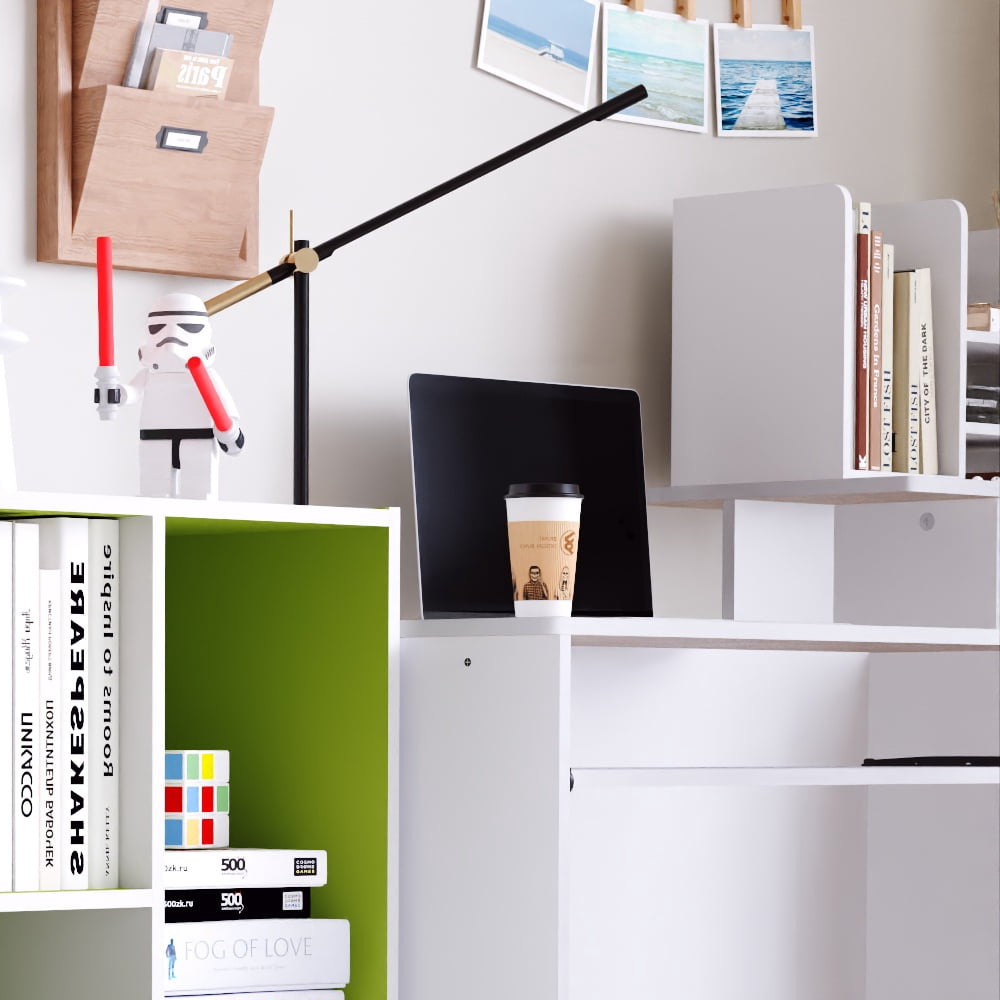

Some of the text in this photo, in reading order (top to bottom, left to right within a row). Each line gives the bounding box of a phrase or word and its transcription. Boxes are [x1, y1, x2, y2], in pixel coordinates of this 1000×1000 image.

[920, 323, 928, 352] DARK
[873, 304, 881, 408] Gardens in France
[923, 382, 929, 396] OF
[910, 384, 918, 471] LOST FISH
[883, 418, 891, 468] LOST
[221, 858, 246, 872] 500
[220, 892, 243, 907] 500
[184, 936, 313, 960] FOG OF LOVE
